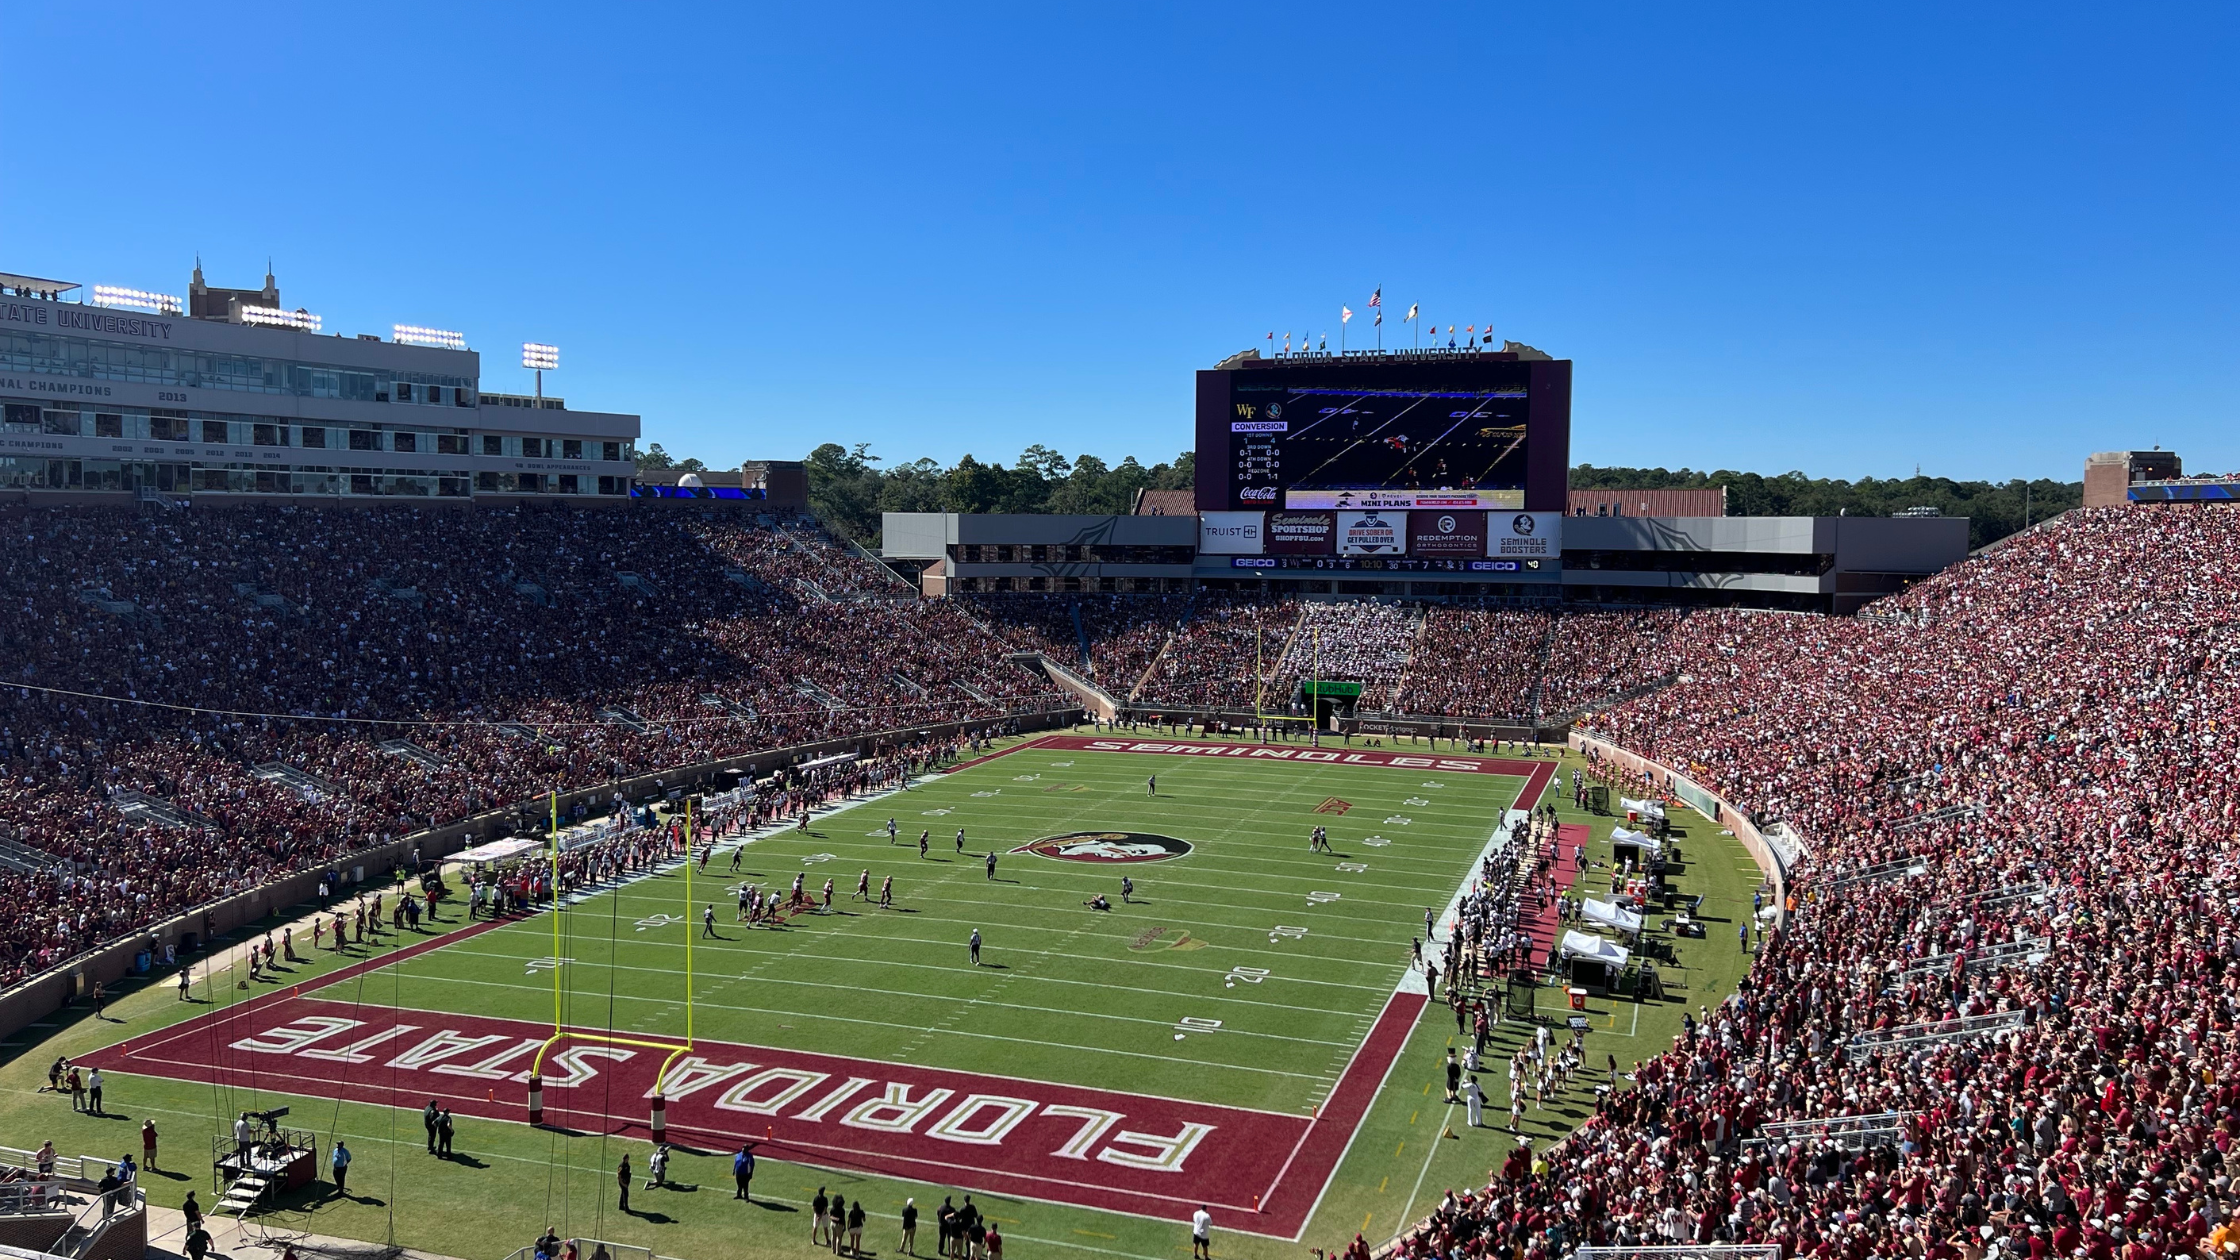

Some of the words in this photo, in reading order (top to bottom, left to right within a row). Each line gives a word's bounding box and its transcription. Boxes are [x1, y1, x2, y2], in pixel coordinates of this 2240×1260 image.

[58, 310, 172, 340] UNIVERSITY
[1274, 351, 1333, 365] FLORIDA
[1341, 348, 1387, 363] STATE
[1394, 346, 1483, 362] UNIVERSITY
[29, 380, 112, 397] CHAMPIONS
[158, 391, 187, 403] 2013
[1235, 422, 1285, 431] CONVERSION
[9, 440, 63, 450] CHAMPIONS
[206, 449, 225, 457] 2012
[1270, 512, 1331, 526] Seminole
[1206, 527, 1241, 536] TRUIST
[1271, 525, 1330, 533] SPORTSHOP
[1500, 538, 1547, 546] SEMINOLE
[1500, 546, 1547, 554] BOOSTERS
[1236, 558, 1275, 567] GEICO
[1317, 560, 1324, 568] 0
[1360, 560, 1383, 569] 10:10
[1422, 561, 1429, 569] 7
[1472, 561, 1516, 570] GEICO
[1313, 684, 1354, 694] StubHub
[1249, 718, 1273, 726] TRUST
[1084, 741, 1481, 771] SEMINOLES
[1224, 966, 1271, 984] 20
[1173, 1016, 1223, 1034] 10
[227, 1015, 638, 1089] STATE
[641, 1054, 1219, 1173] FLORIDA
